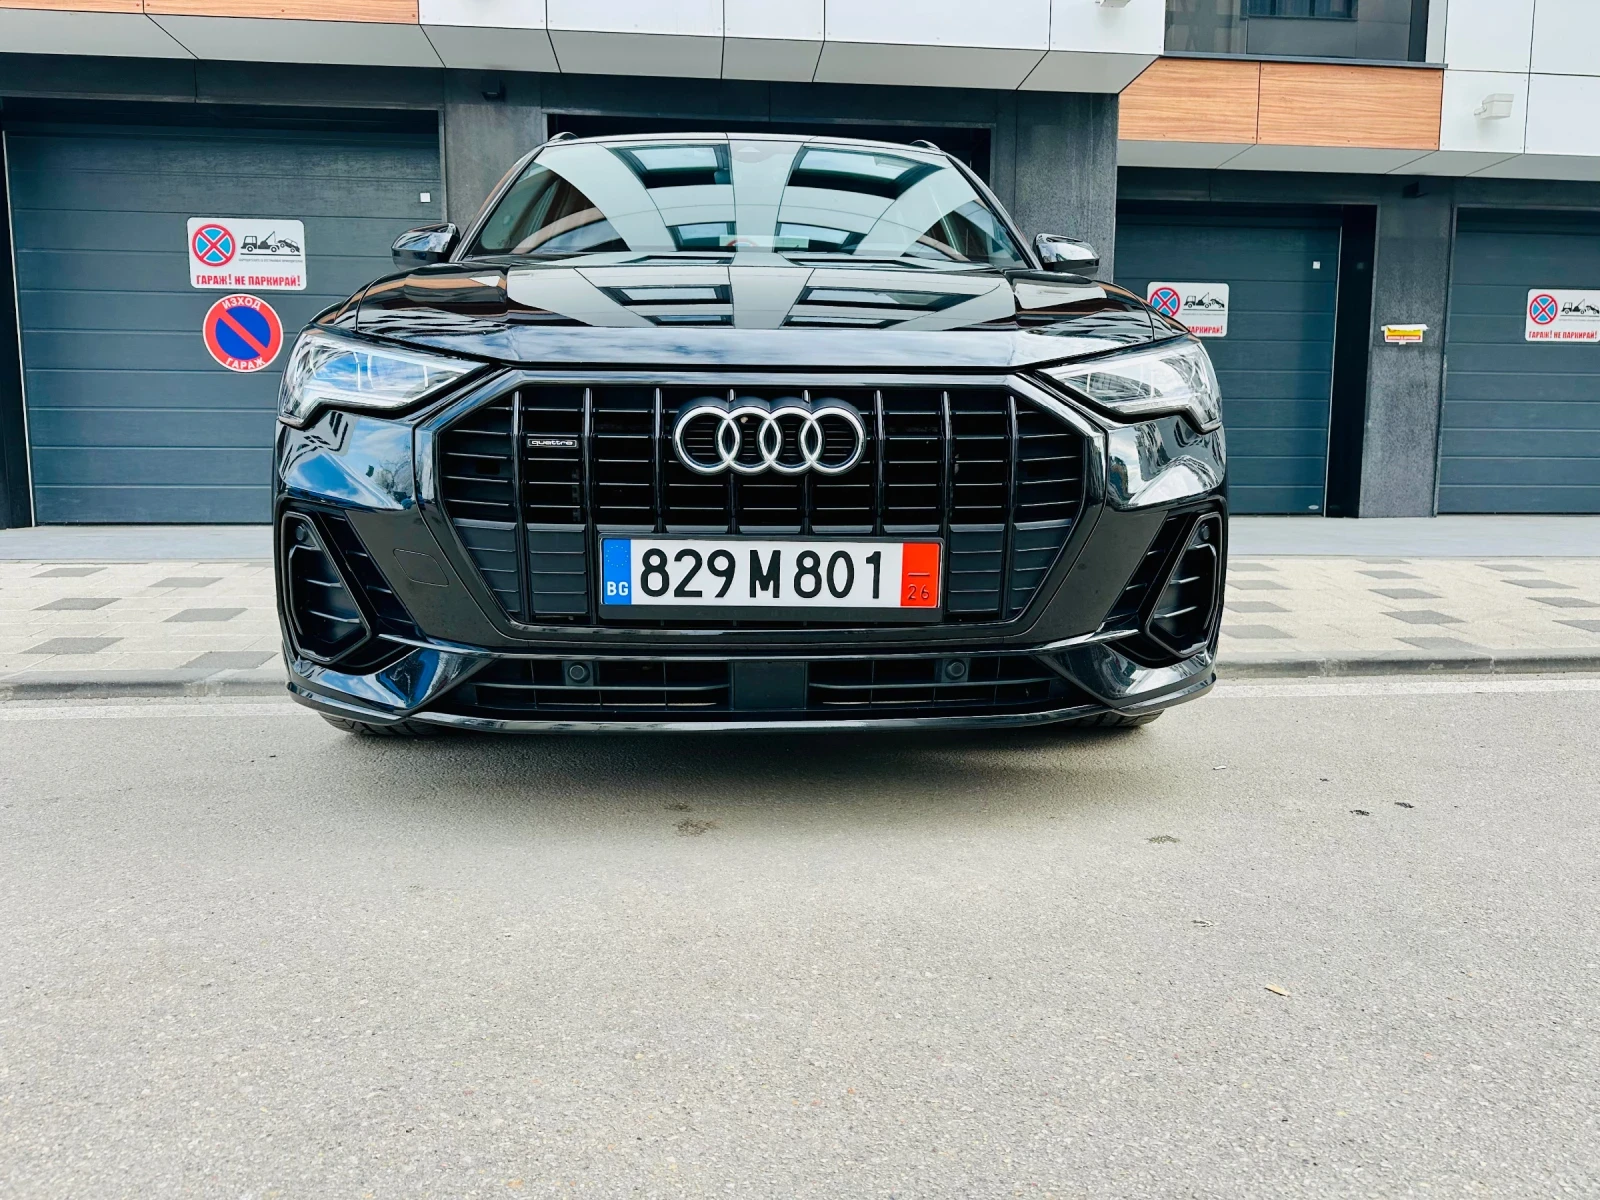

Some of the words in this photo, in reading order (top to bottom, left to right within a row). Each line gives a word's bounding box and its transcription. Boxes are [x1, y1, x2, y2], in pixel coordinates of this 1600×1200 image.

[196, 273, 232, 285] ГАРАЖ!
[234, 275, 246, 285] НЕ
[248, 275, 301, 287] ПАРКИРАЙ!
[222, 297, 261, 311] ИЗХОД
[1528, 330, 1553, 339] ГАРАЖ!
[1553, 331, 1561, 339] НЕ
[1562, 330, 1597, 340] ПАРКИРАЙ!
[225, 357, 266, 370] ГАРАЖ
[530, 439, 575, 448] quattro
[640, 547, 736, 598] 829
[793, 550, 882, 599] 801
[607, 581, 629, 596] BG
[907, 583, 930, 600] 26
